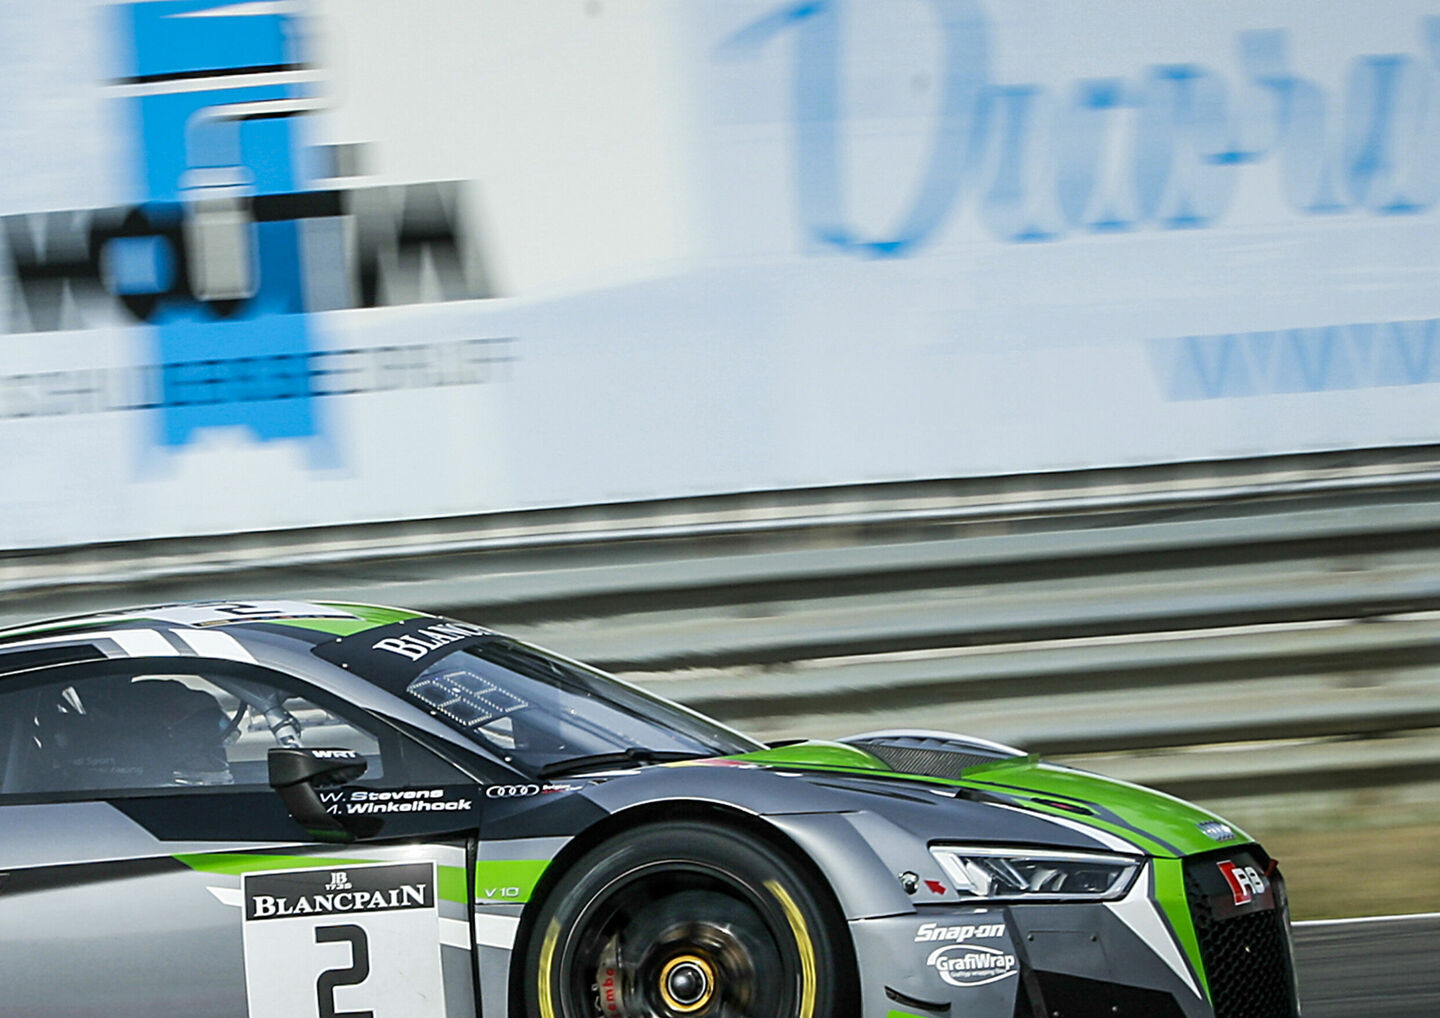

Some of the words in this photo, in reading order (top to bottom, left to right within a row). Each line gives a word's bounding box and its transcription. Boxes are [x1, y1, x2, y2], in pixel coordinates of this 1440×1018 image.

[312, 750, 357, 759] WRT
[319, 792, 346, 803] W.
[350, 789, 444, 802] Stevens
[1231, 866, 1265, 896] R8
[253, 884, 427, 917] BLANCPAIN
[914, 923, 1006, 943] Snap-on
[936, 953, 1015, 971] GrafiWrap
